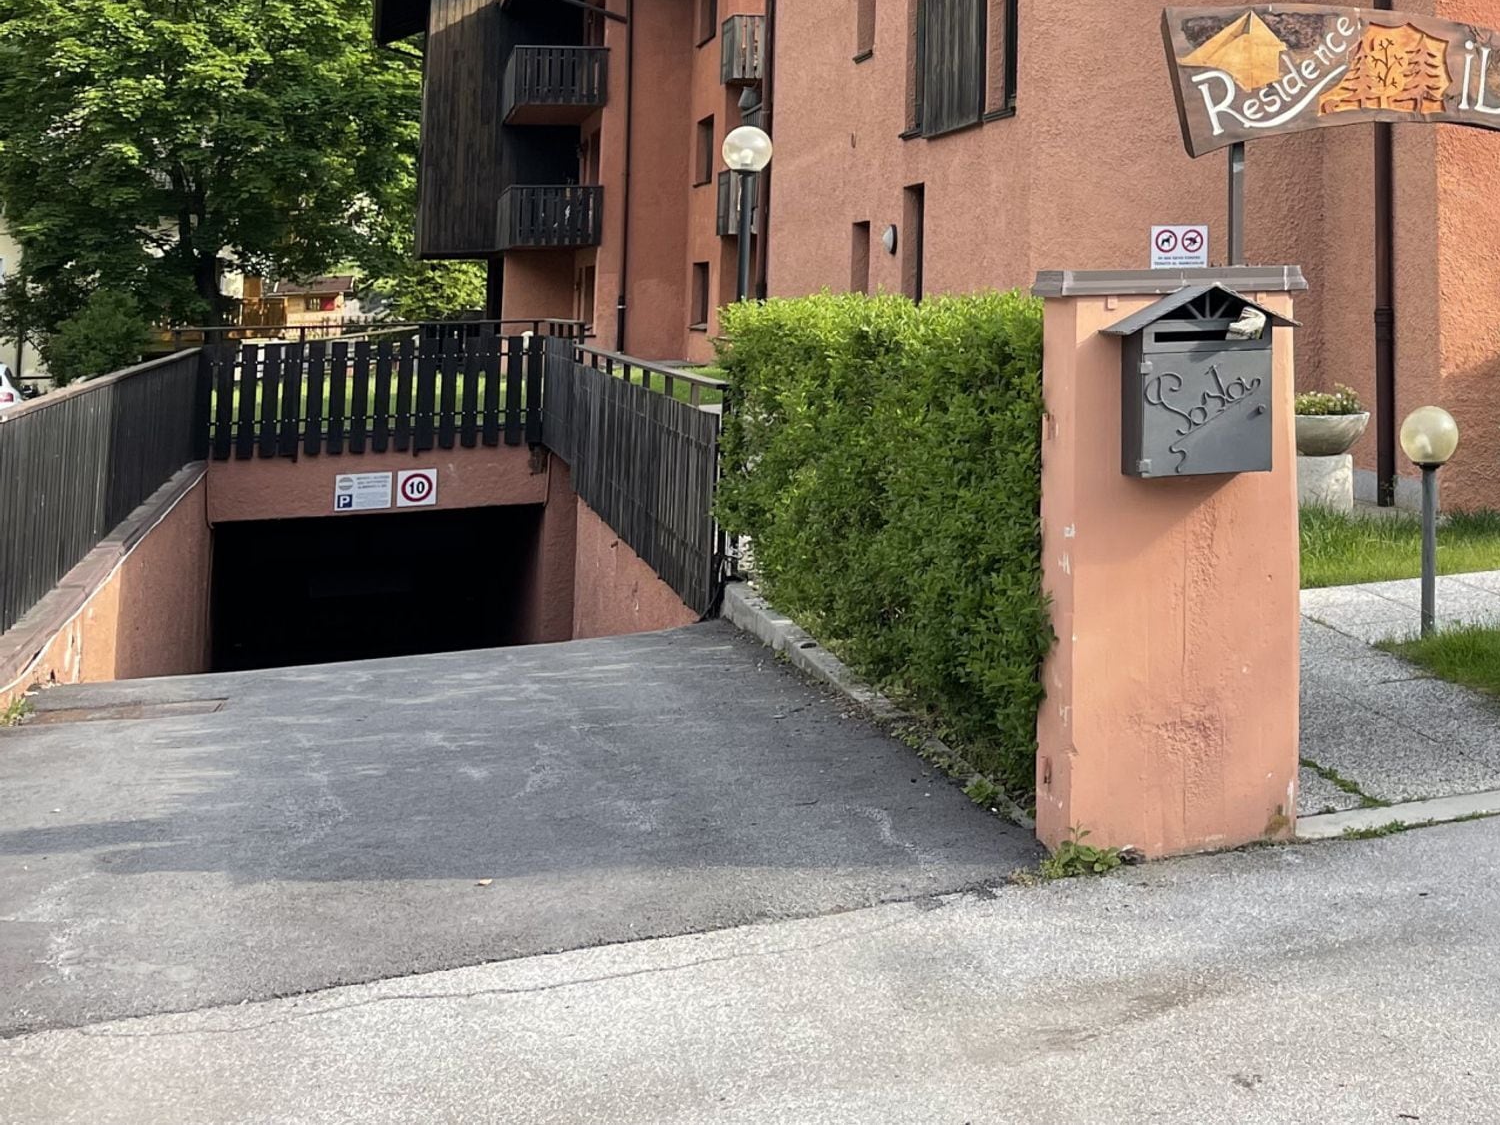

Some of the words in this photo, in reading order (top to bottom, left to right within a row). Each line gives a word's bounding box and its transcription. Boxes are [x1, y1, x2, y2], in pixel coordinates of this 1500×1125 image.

[1191, 17, 1354, 136] Residence
[1144, 363, 1261, 436] Posta
[339, 495, 351, 508] P
[409, 481, 425, 495] 10
